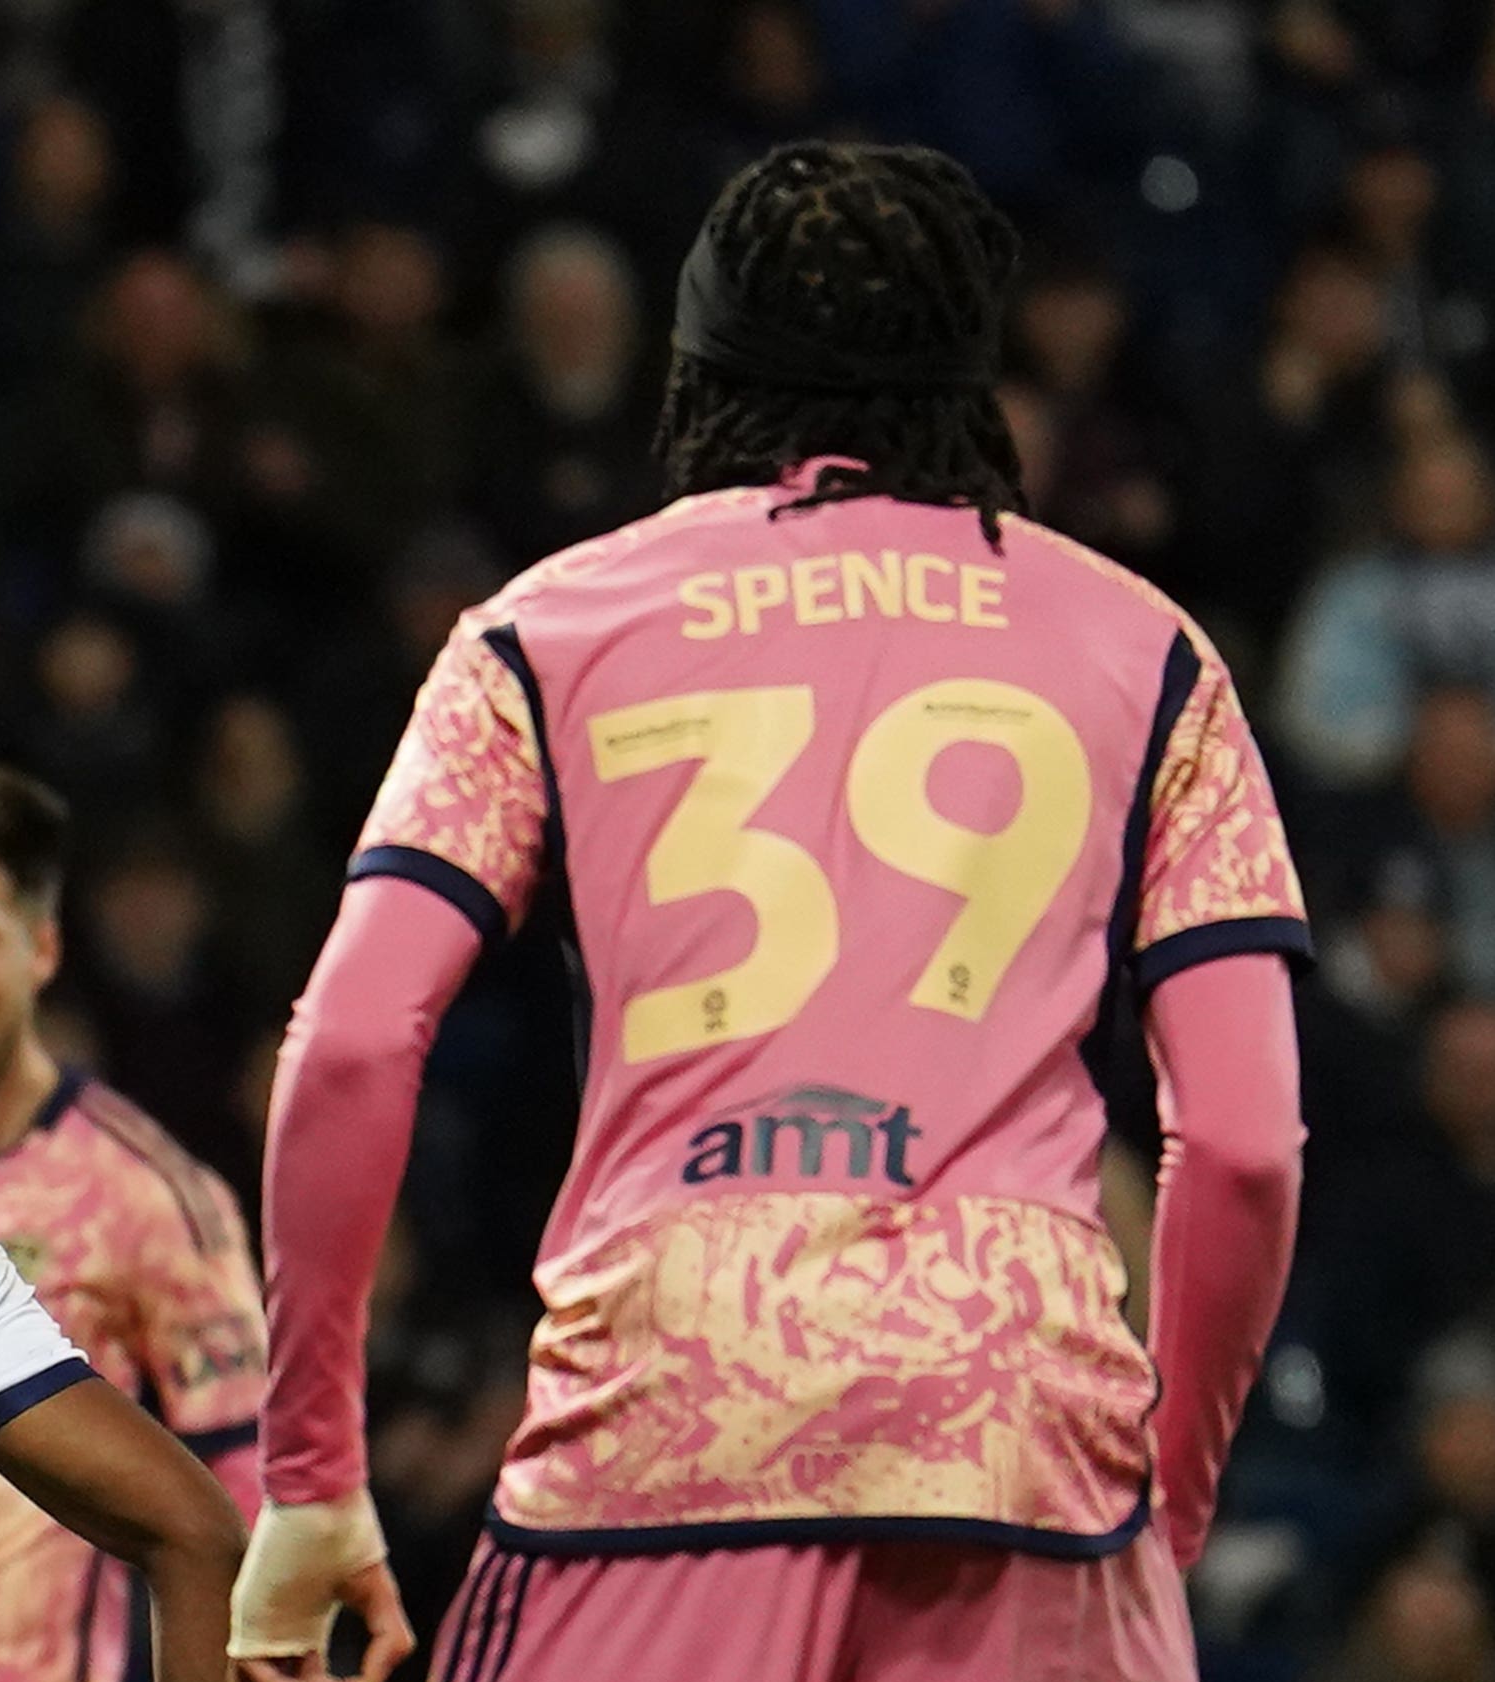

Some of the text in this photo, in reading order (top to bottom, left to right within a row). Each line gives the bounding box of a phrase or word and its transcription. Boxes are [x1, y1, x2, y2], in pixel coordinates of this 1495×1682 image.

[681, 548, 1009, 641] SPENCE
[587, 677, 1092, 1063] 39
[682, 1101, 923, 1187] amt
